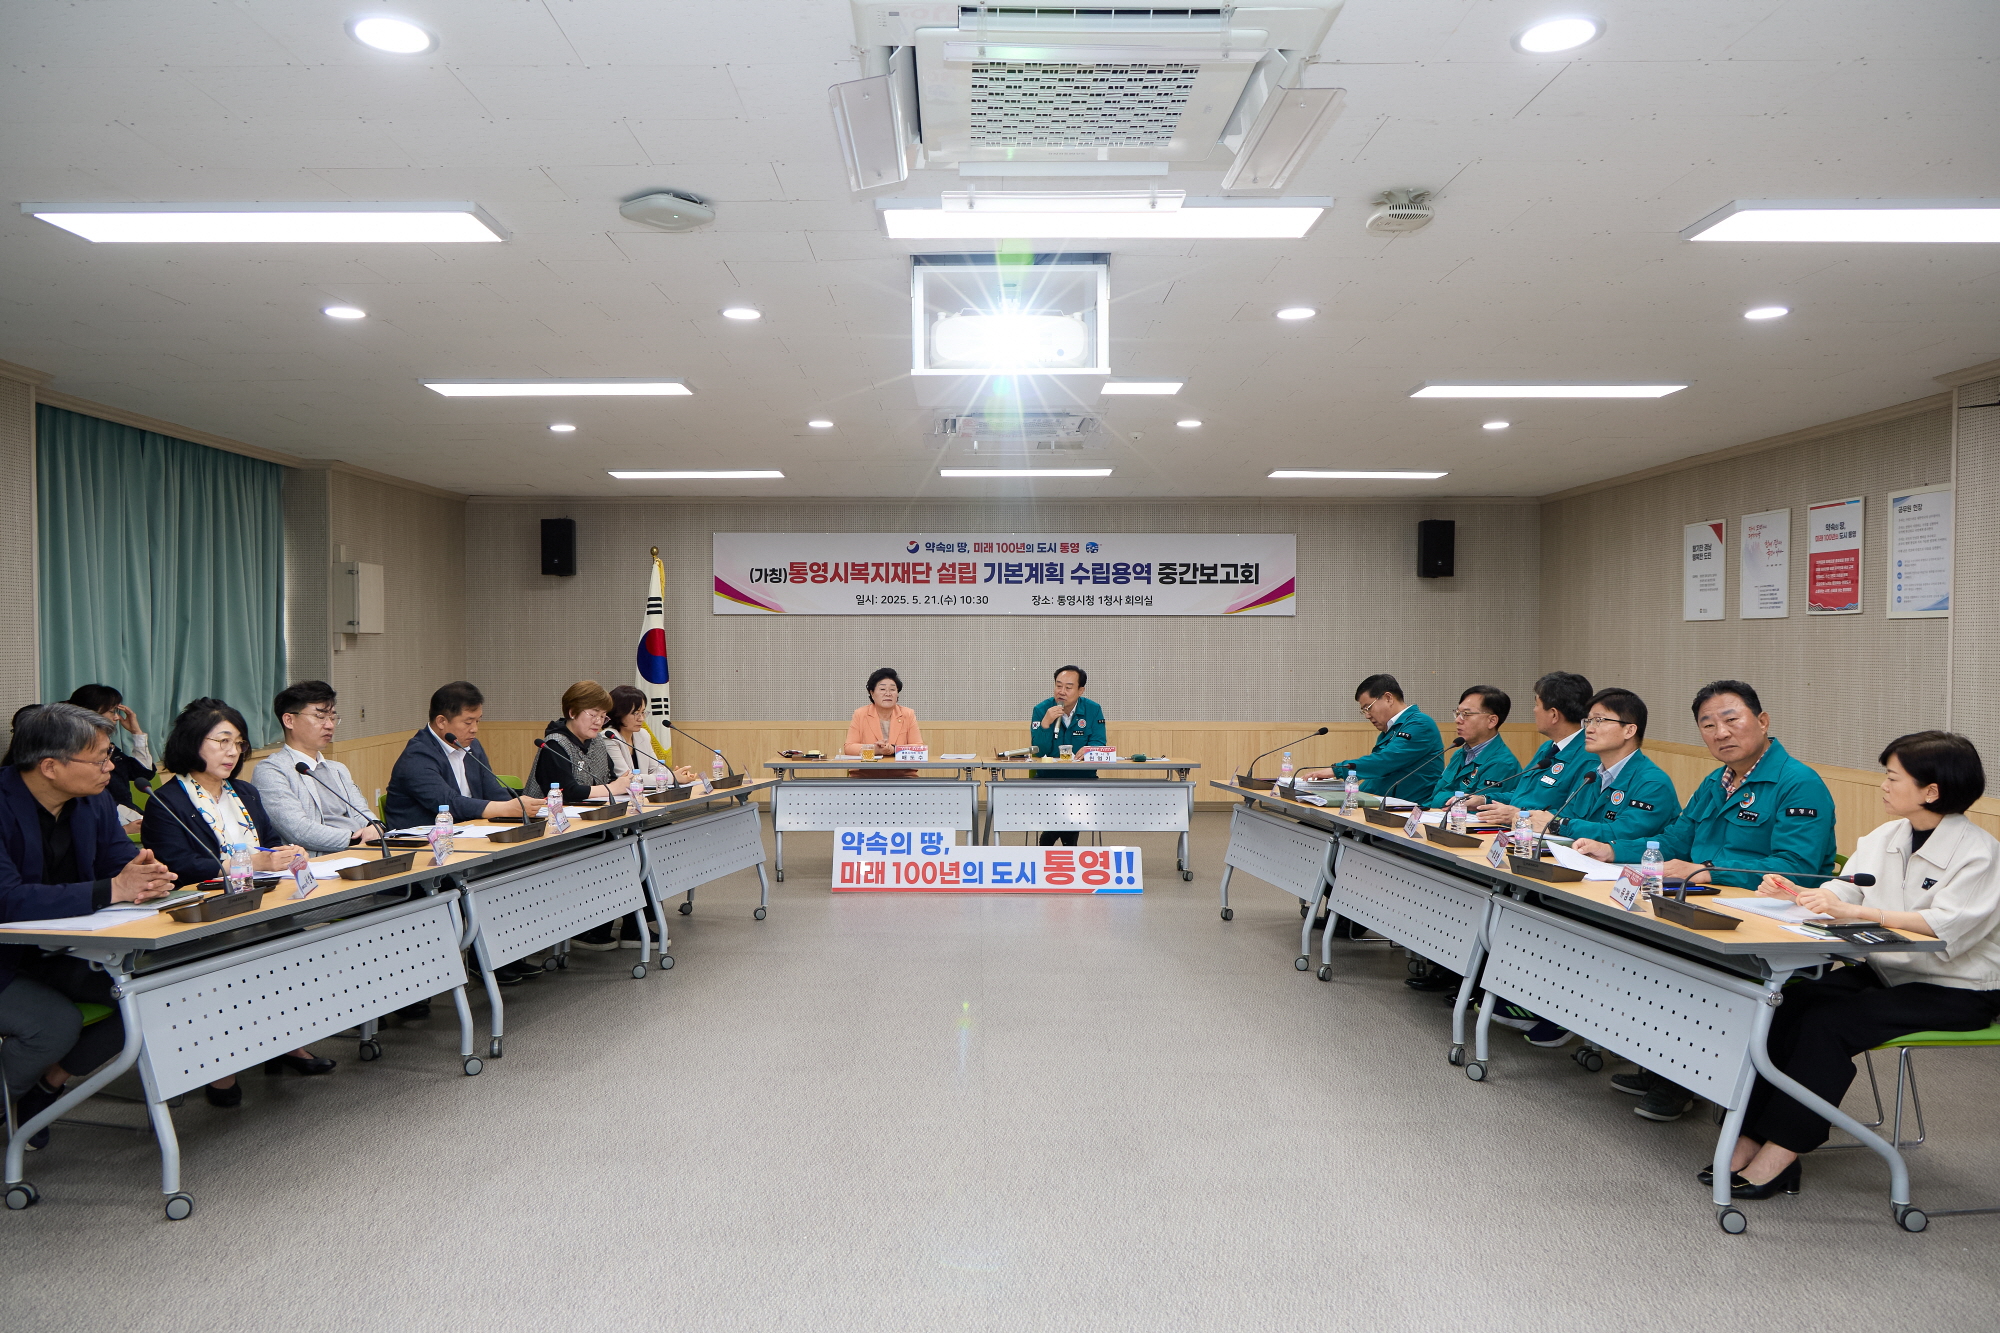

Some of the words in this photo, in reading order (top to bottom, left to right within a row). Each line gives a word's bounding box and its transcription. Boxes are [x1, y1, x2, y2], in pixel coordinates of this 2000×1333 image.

[924, 541, 955, 554] 약속의
[957, 541, 970, 554] 땅,
[973, 541, 994, 554] 미래
[995, 542, 1035, 554] 100년의
[1036, 542, 1057, 554] 도시
[1059, 542, 1080, 554] 통영
[749, 561, 933, 585] (가칭)통영시복지재단
[936, 561, 977, 585] 설립
[983, 562, 1065, 586] 기본계획
[1070, 562, 1153, 586] 수립용역
[1157, 562, 1260, 586] 중간보고회
[855, 594, 878, 606] 일시:
[880, 595, 910, 605] 2025.
[911, 595, 922, 605] 5.
[923, 594, 957, 606] 21.(수)
[959, 595, 989, 605] 10:30
[1031, 594, 1054, 607] 장소:
[1056, 594, 1095, 607] 통영시청
[1097, 594, 1122, 607] 1청사
[1124, 594, 1153, 607] 회의실
[841, 831, 912, 856] 약속의
[920, 831, 950, 856] 땅,
[840, 861, 886, 885] 미래
[892, 861, 984, 885] 100년의
[991, 861, 1037, 885] 도시
[1043, 849, 1136, 886] 통영!!
